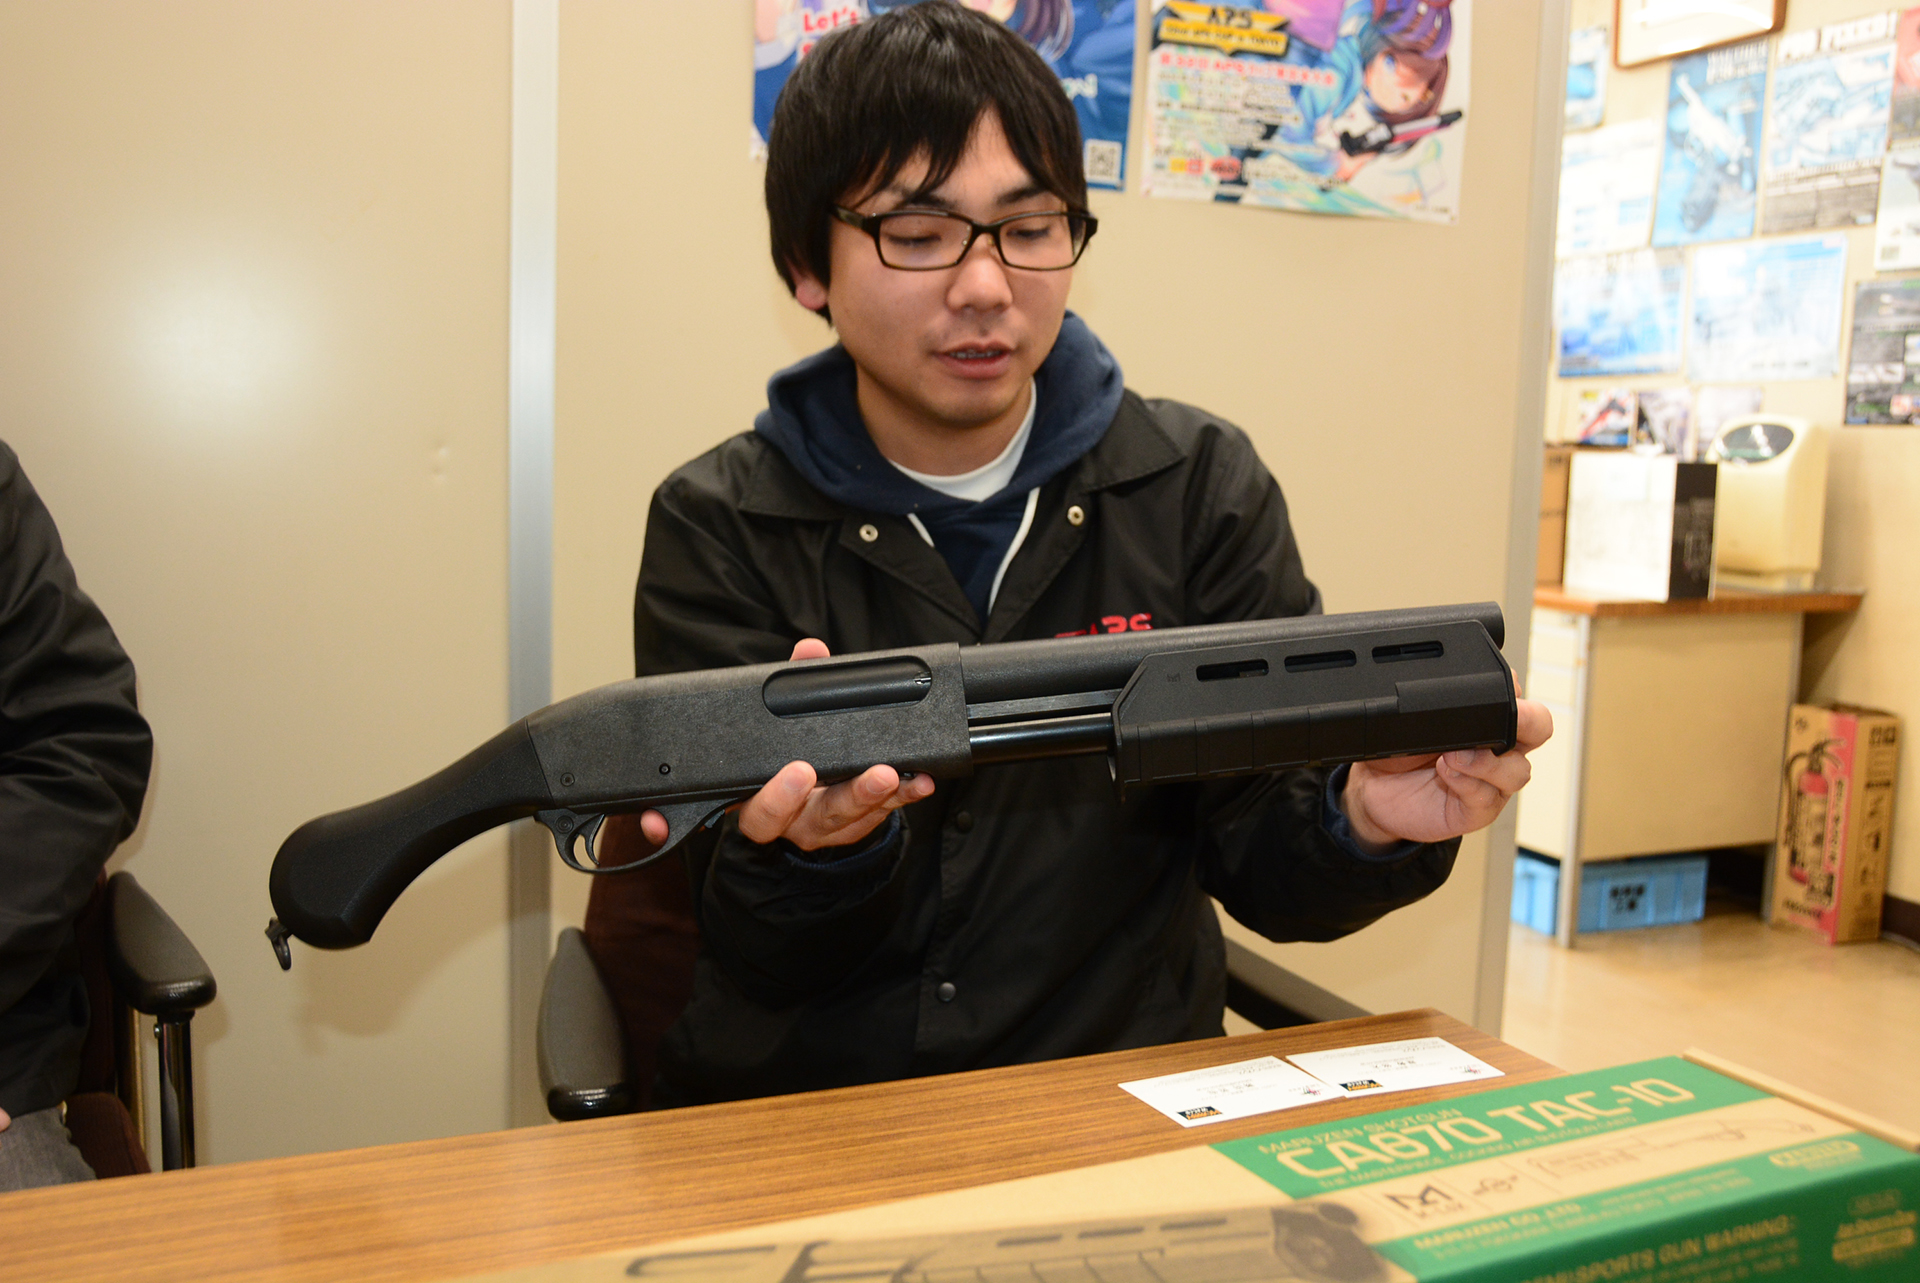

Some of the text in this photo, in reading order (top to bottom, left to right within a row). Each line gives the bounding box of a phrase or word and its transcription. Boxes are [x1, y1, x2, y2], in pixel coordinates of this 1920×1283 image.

[1207, 6, 1252, 29] APS
[1258, 1108, 1463, 1154] MARUZEN SHOTGUN
[1276, 1077, 1696, 1178] CA870 TAC-10
